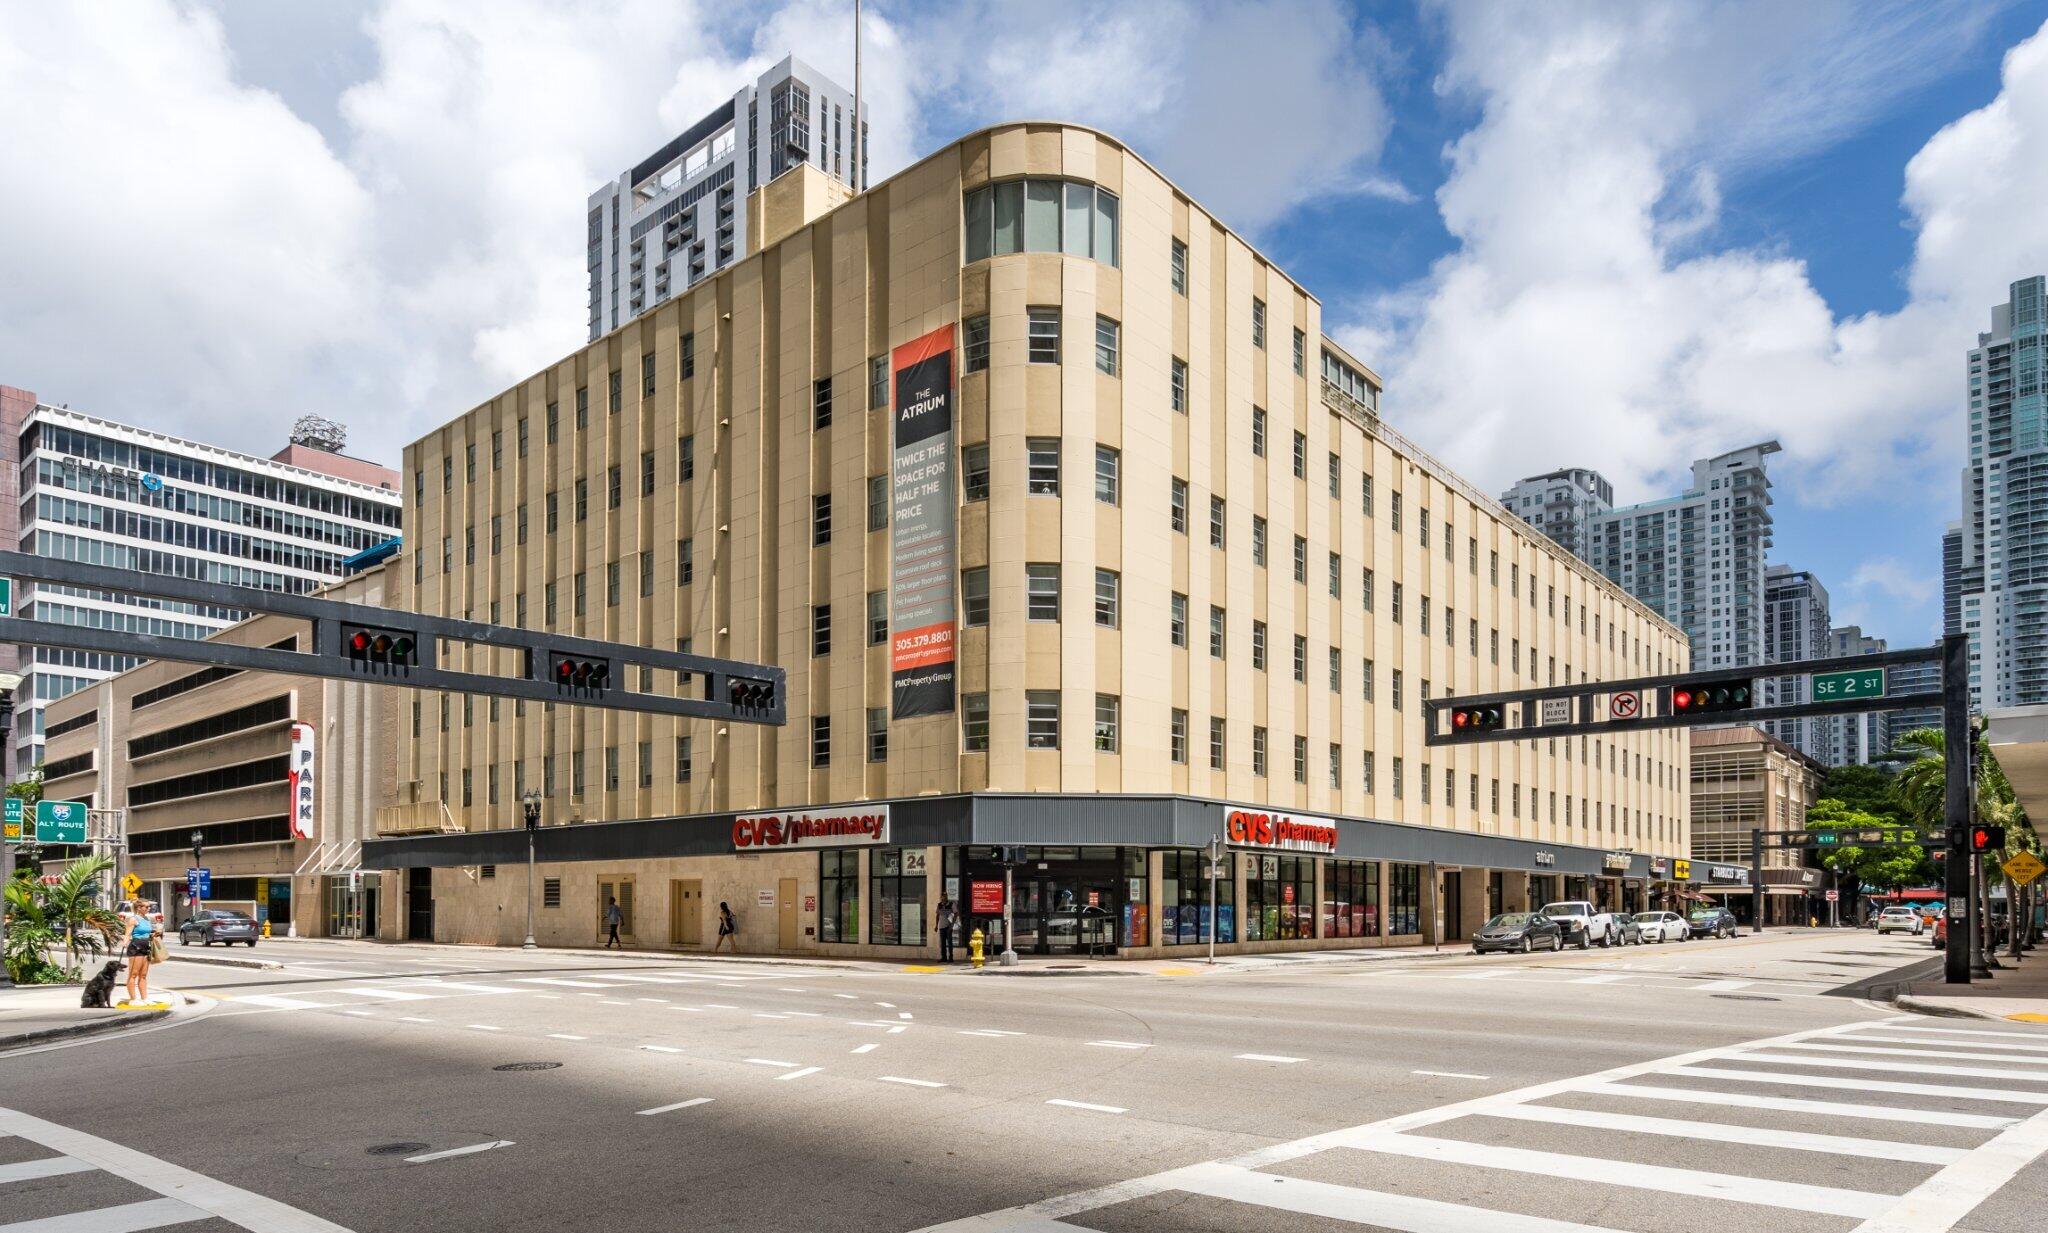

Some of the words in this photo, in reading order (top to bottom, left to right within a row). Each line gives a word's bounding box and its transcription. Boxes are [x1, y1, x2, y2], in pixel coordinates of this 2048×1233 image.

[915, 387, 931, 401] THE
[901, 393, 945, 421] ATRIUM
[896, 450, 926, 469] TWICE
[926, 442, 946, 459] THE
[62, 456, 139, 486] CHASE
[896, 468, 925, 487] SPACE
[926, 461, 946, 477] FOR
[896, 486, 920, 504] HALF
[921, 480, 940, 496] THE
[896, 503, 923, 522] PRICE
[895, 630, 952, 651] 305.379.8801
[1817, 681, 1836, 694] SE
[1844, 678, 1856, 693] 2
[1864, 678, 1878, 689] ST
[1546, 709, 1566, 717] BLOCK
[1556, 700, 1567, 708] NOT
[299, 749, 313, 820] PARK
[55, 808, 70, 818] 95
[58, 821, 85, 829] ROUTE
[732, 814, 885, 848] CVS/pharmacy
[1227, 810, 1338, 849] CVS/pharmacy
[907, 855, 926, 869] 24
[1264, 861, 1275, 874] 24
